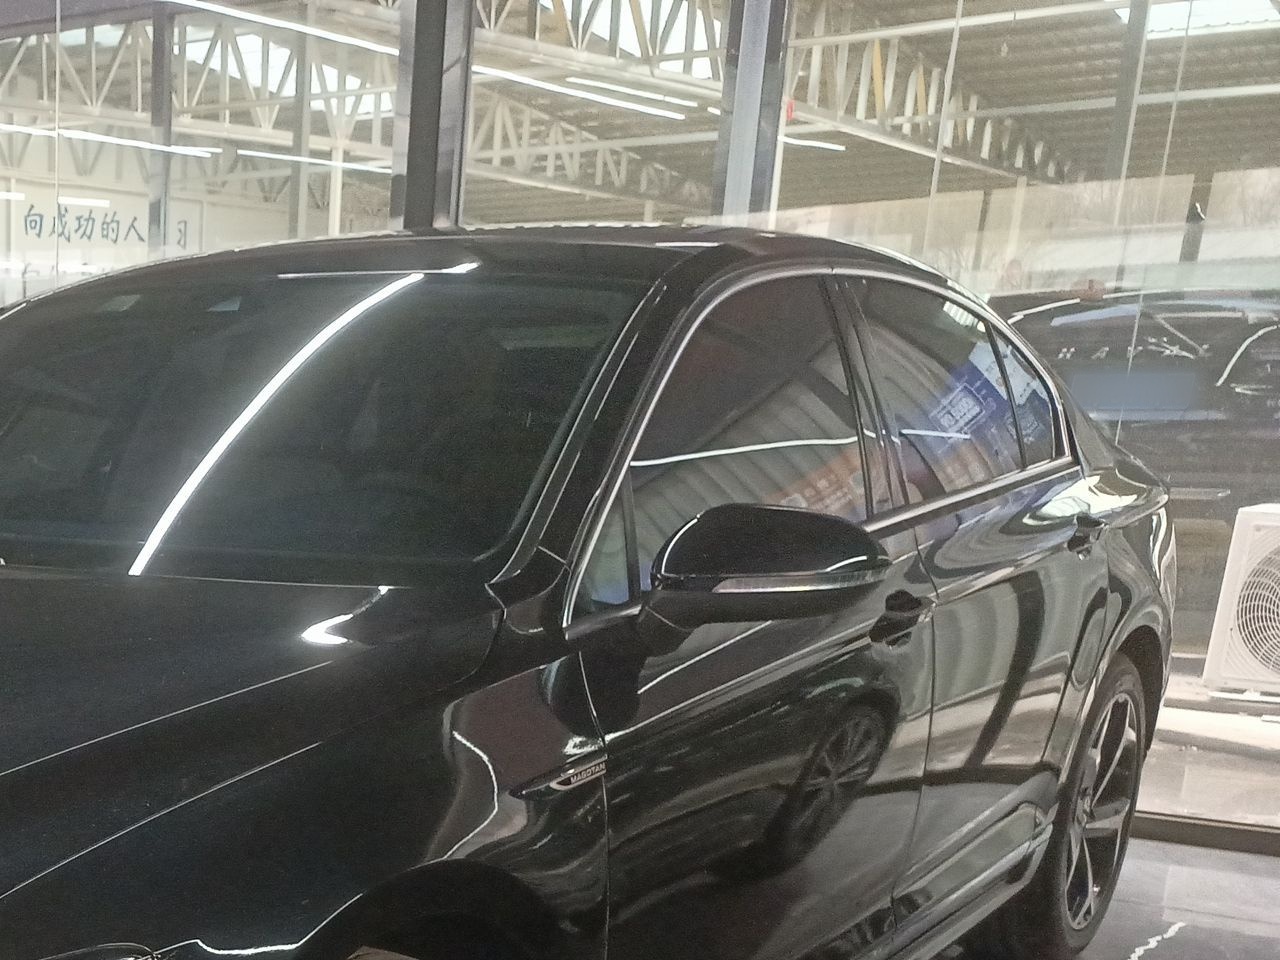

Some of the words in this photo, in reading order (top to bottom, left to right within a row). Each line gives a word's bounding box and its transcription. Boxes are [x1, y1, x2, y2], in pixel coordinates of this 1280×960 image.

[24, 203, 187, 250] 向成功的人习
[570, 761, 606, 784] MAGOTAN
